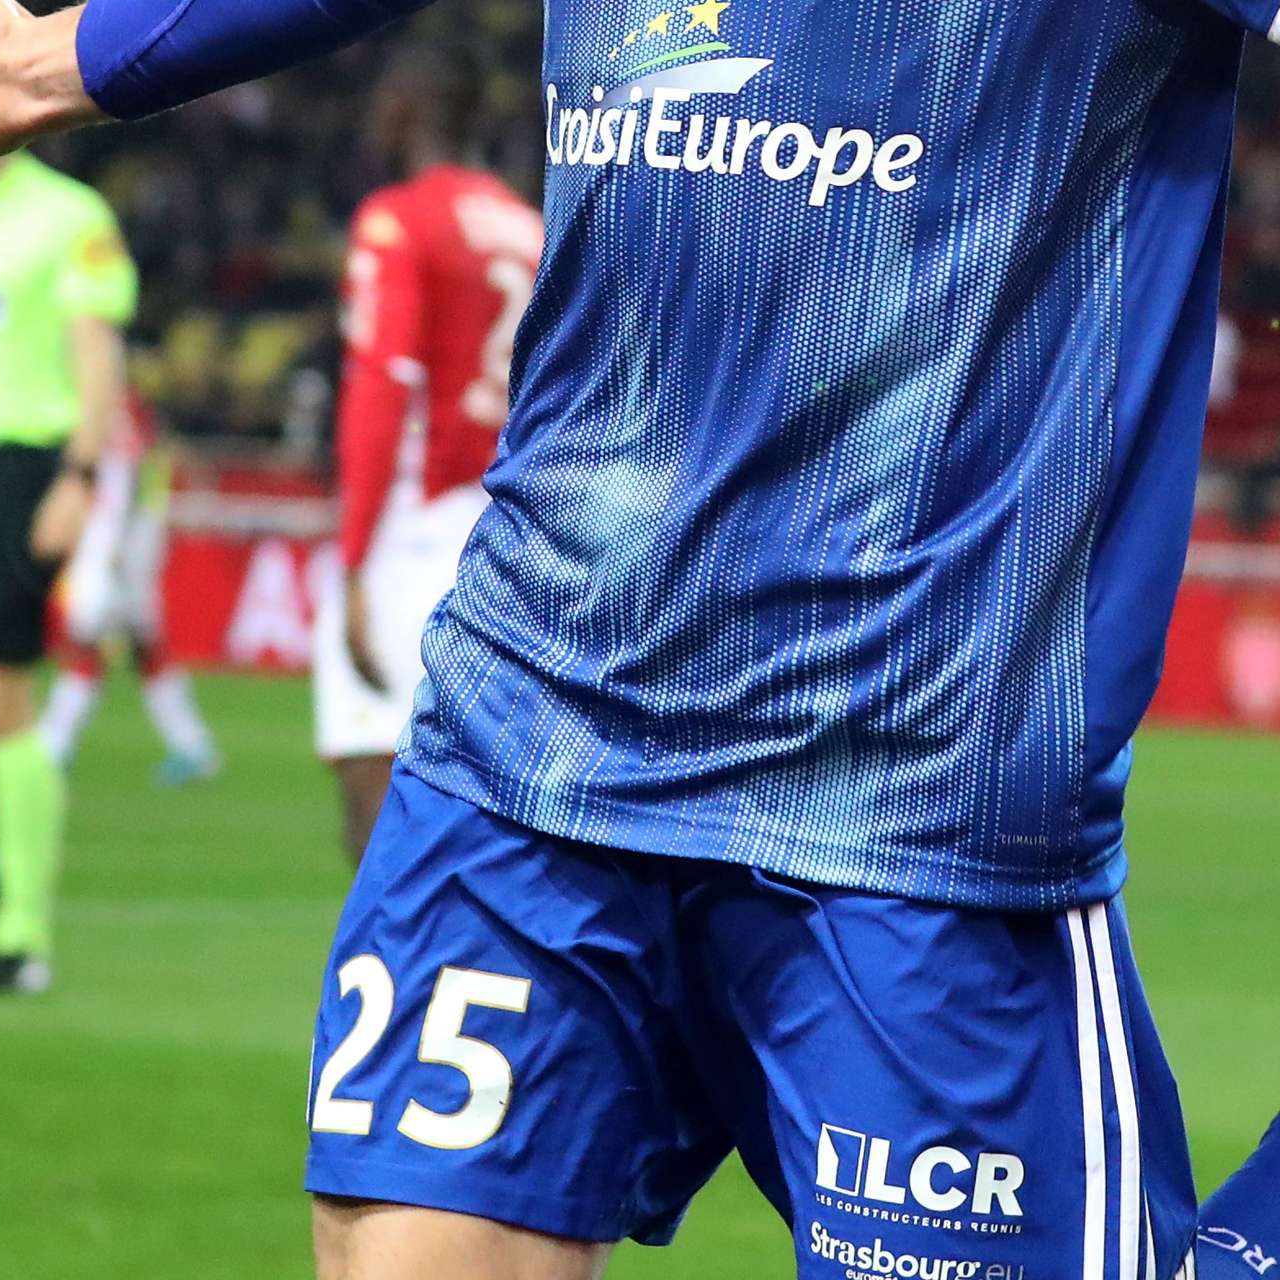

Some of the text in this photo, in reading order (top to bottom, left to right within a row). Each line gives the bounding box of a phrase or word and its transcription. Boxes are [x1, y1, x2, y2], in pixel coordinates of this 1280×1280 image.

[546, 83, 924, 207] CroisiEurope
[311, 953, 532, 1150] 25
[836, 1200, 962, 1231] CONSTRUCTEURS
[864, 1137, 1024, 1217] LCR
